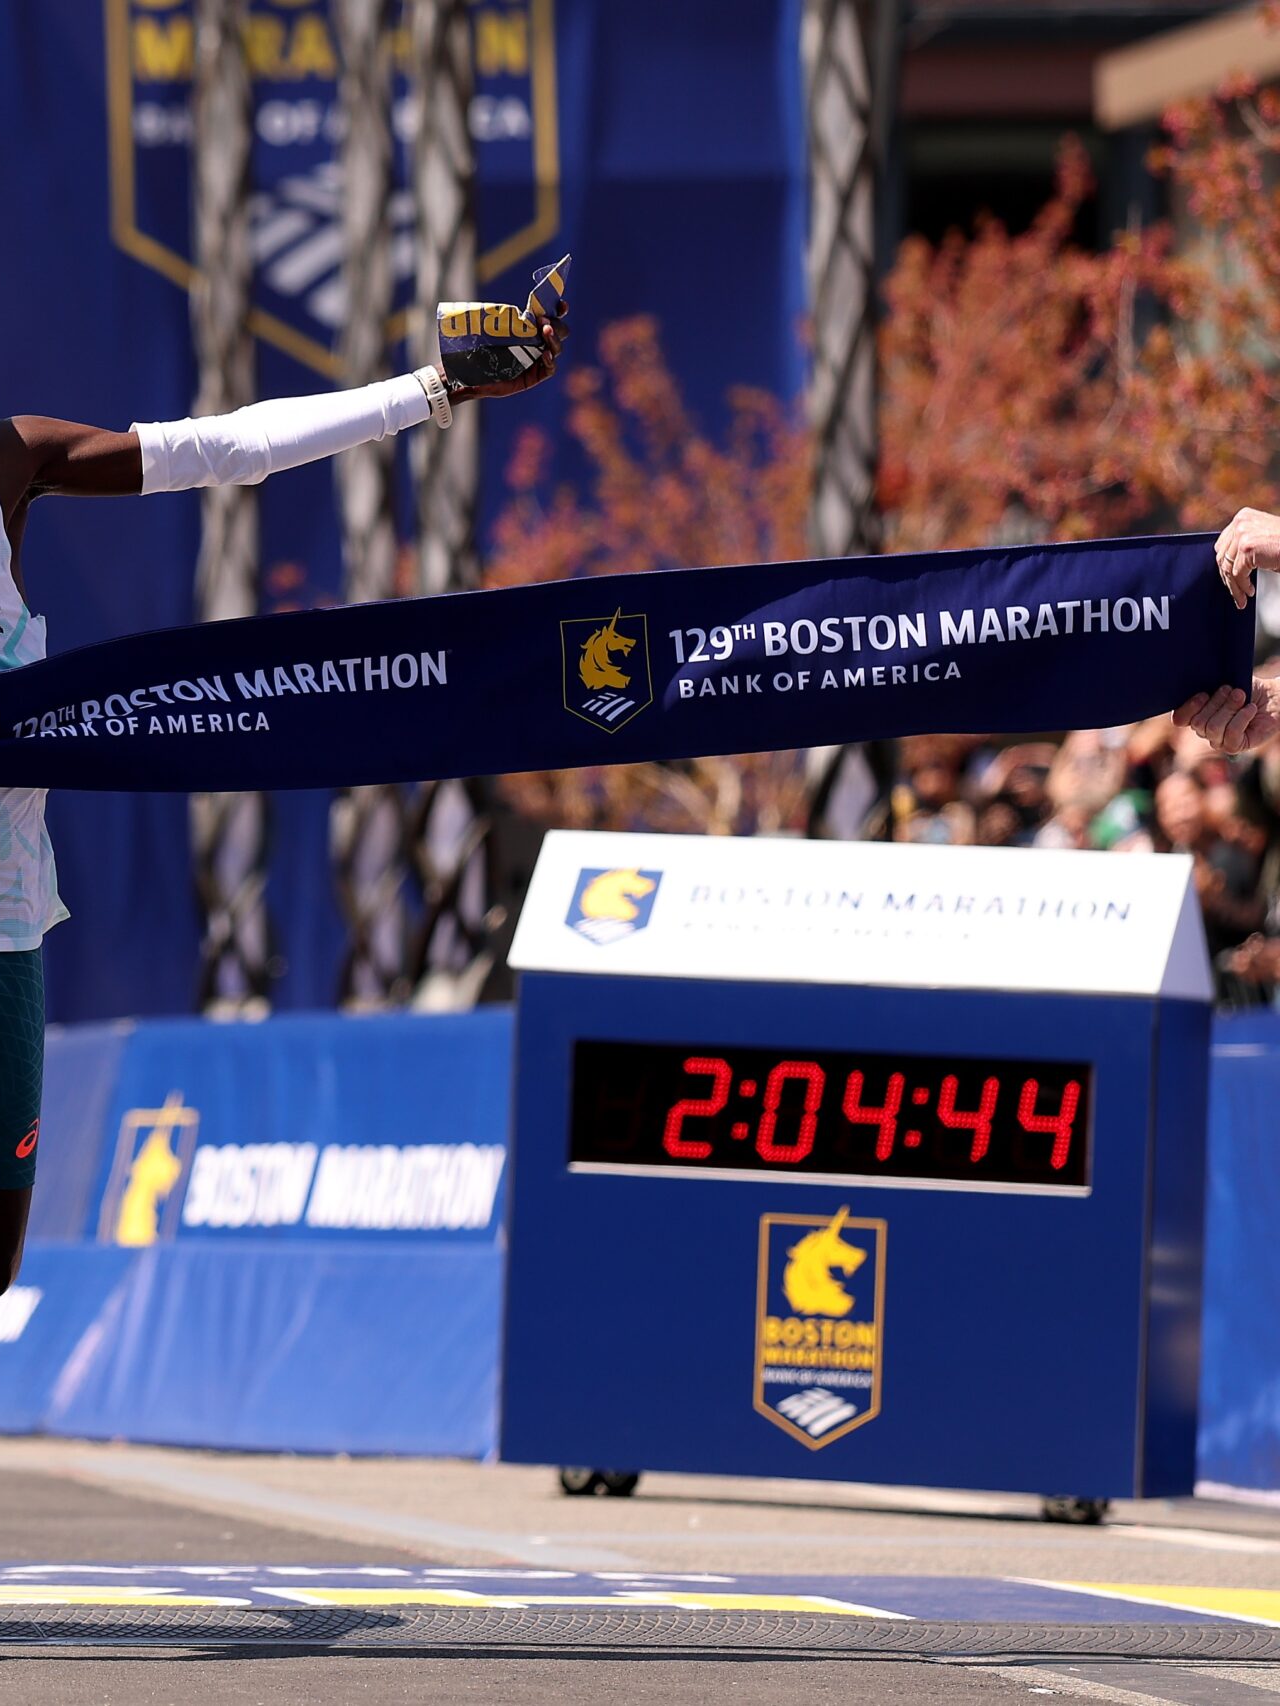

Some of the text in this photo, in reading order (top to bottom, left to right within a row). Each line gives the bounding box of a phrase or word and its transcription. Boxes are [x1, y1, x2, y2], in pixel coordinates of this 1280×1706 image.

[668, 595, 1170, 664] 129TH BOSTON MARATHON
[234, 650, 448, 700] MARATHON
[678, 661, 962, 699] BANK OF AMERICA
[104, 717, 140, 737] OF
[147, 710, 271, 735] AMERICA
[662, 1056, 1081, 1170] 2:04:44
[765, 1316, 874, 1348] BOSTON
